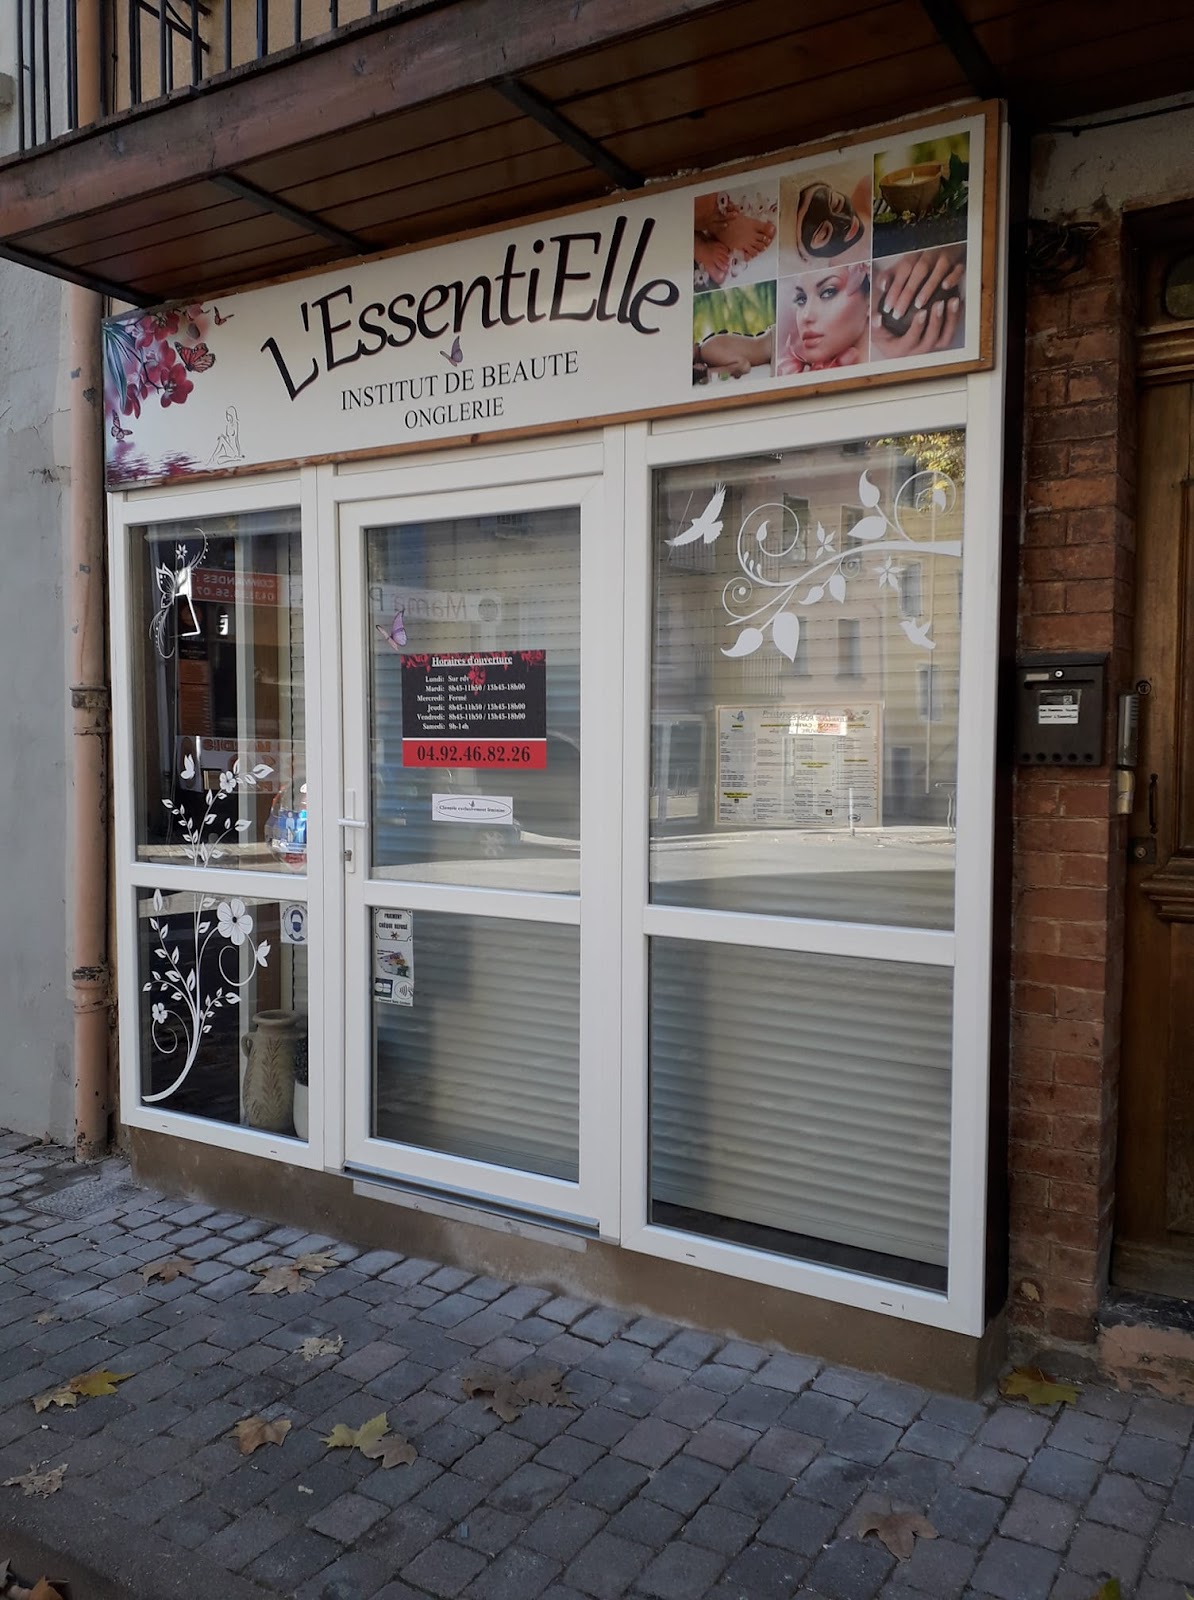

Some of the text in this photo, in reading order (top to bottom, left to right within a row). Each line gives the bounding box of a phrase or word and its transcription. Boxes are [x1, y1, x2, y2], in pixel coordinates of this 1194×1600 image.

[261, 216, 679, 400] L'EssentiElle
[341, 350, 580, 411] INSTITUT DE BEAUTE
[404, 397, 505, 430] ONGLERIE
[432, 655, 513, 667] Horaires d'ouverture
[425, 675, 445, 683] Lundi:
[417, 693, 467, 702] Mercredi: Fermé
[427, 704, 445, 713] Jeudi:
[417, 713, 445, 721] Vendredi:
[422, 722, 445, 730] Samedi:
[417, 745, 531, 762] 04.92.46.82.26
